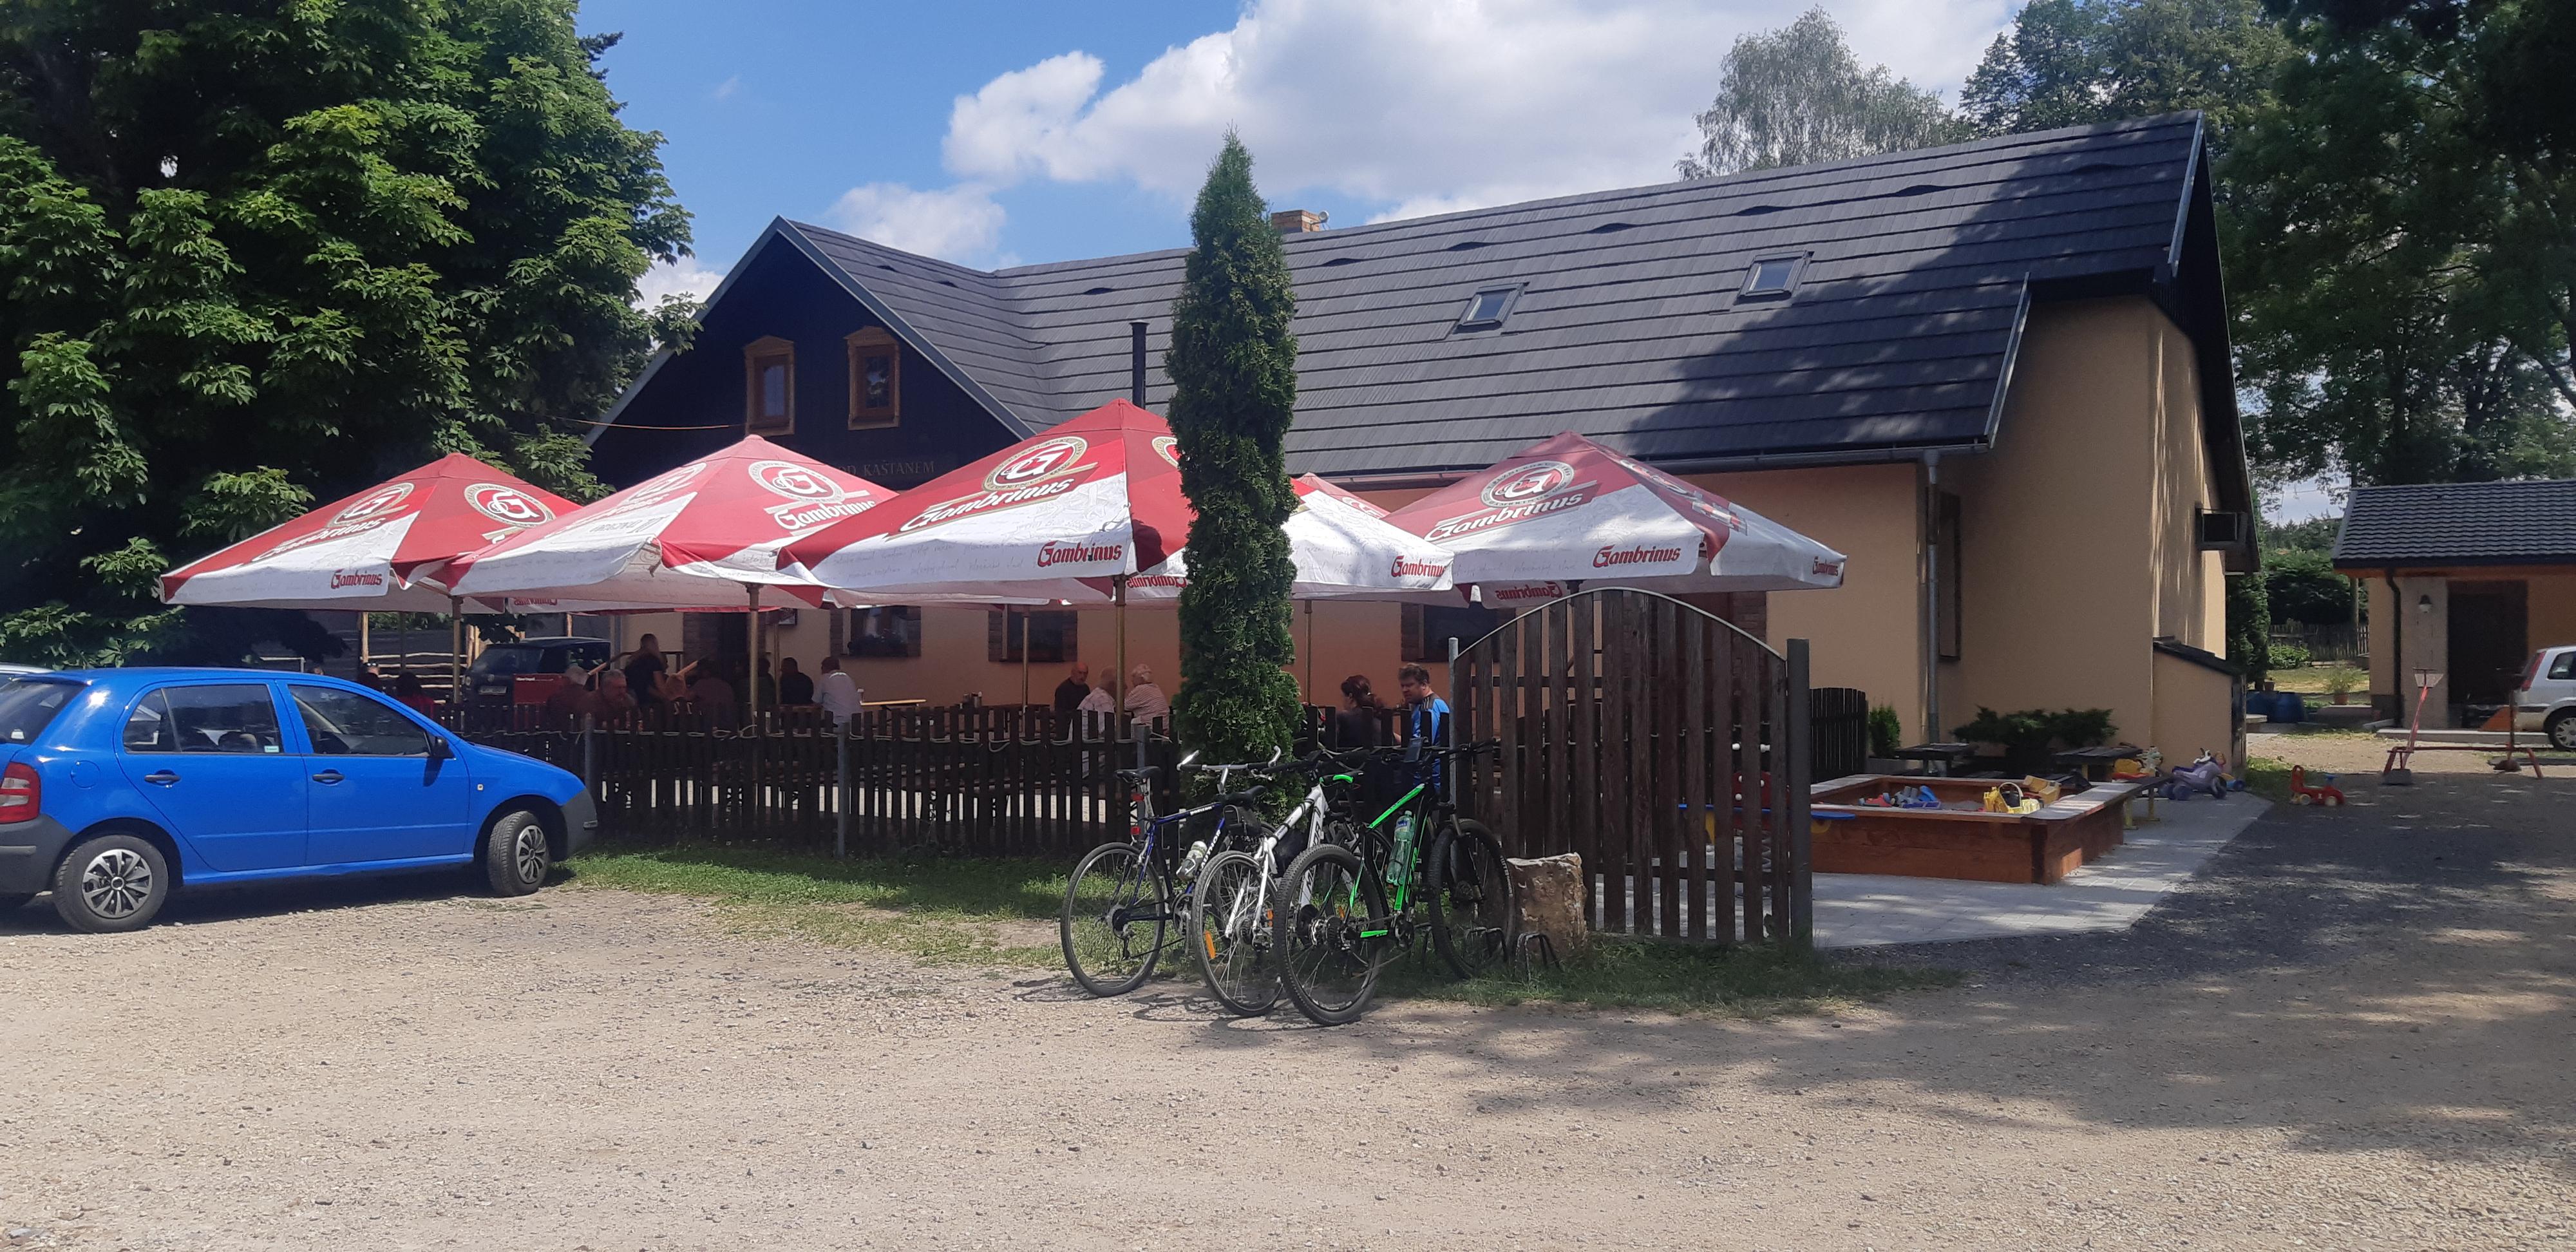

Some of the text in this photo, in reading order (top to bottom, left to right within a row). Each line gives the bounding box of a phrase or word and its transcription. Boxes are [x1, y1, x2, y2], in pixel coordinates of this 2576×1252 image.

[900, 479, 1075, 532] Gambrinus
[1424, 493, 1584, 542] Gambrinus
[1037, 540, 1122, 567] Gambrinus
[1593, 545, 1681, 569] Gambrinus
[330, 569, 383, 589] Gambrinus
[1200, 828, 1221, 869] AUTHOR
